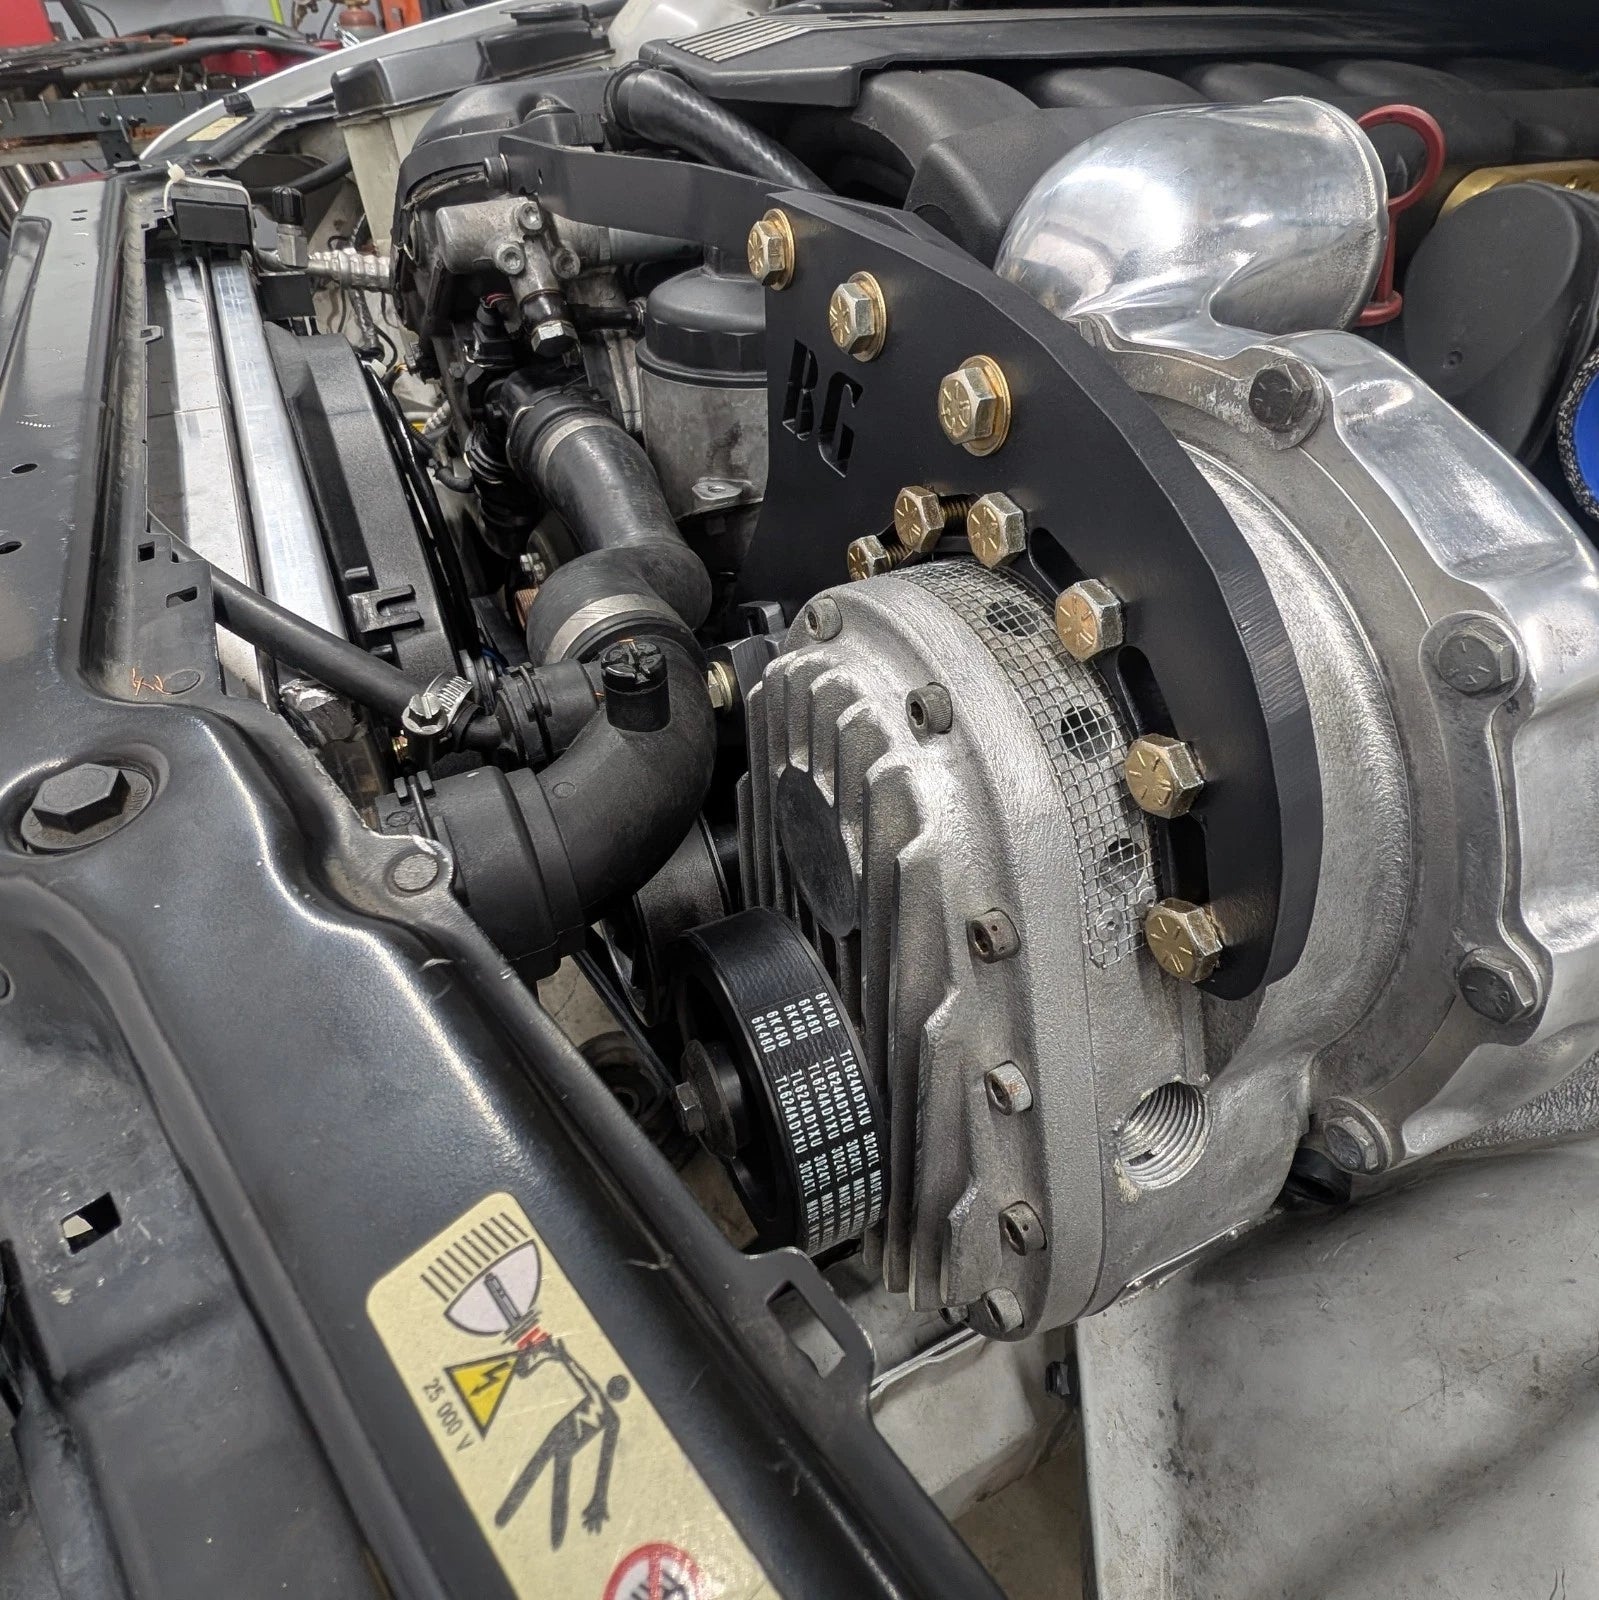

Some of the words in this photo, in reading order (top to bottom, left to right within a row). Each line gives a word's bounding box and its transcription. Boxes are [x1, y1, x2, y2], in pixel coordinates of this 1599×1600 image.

[782, 339, 863, 478] BC
[766, 1010, 791, 1047] 6K480
[783, 1004, 808, 1040] 6K480
[798, 998, 823, 1035] 6K480
[815, 992, 840, 1028] 6K480
[751, 1016, 776, 1053] 6K480
[807, 1062, 840, 1139] TL624AD1XU
[822, 1056, 855, 1133] TL624AD1XU
[840, 1049, 872, 1126] TL624AD1XU
[775, 1075, 808, 1154] TL624AD1XU
[790, 1069, 824, 1147] TL624AD1XU
[831, 1145, 848, 1182] 3024TL
[846, 1139, 863, 1175] 3024TL
[863, 1131, 879, 1167] 3024TL
[799, 1160, 816, 1197] 3024TL
[813, 1153, 831, 1190] 3024TL
[853, 1177, 865, 1201] MADE
[869, 1170, 882, 1194] MADE
[806, 1199, 819, 1224] MADE
[821, 1192, 834, 1217] MADE
[838, 1184, 851, 1208] MADE
[423, 1376, 445, 1403] 25
[437, 1401, 463, 1436] 000
[456, 1433, 475, 1453] V
